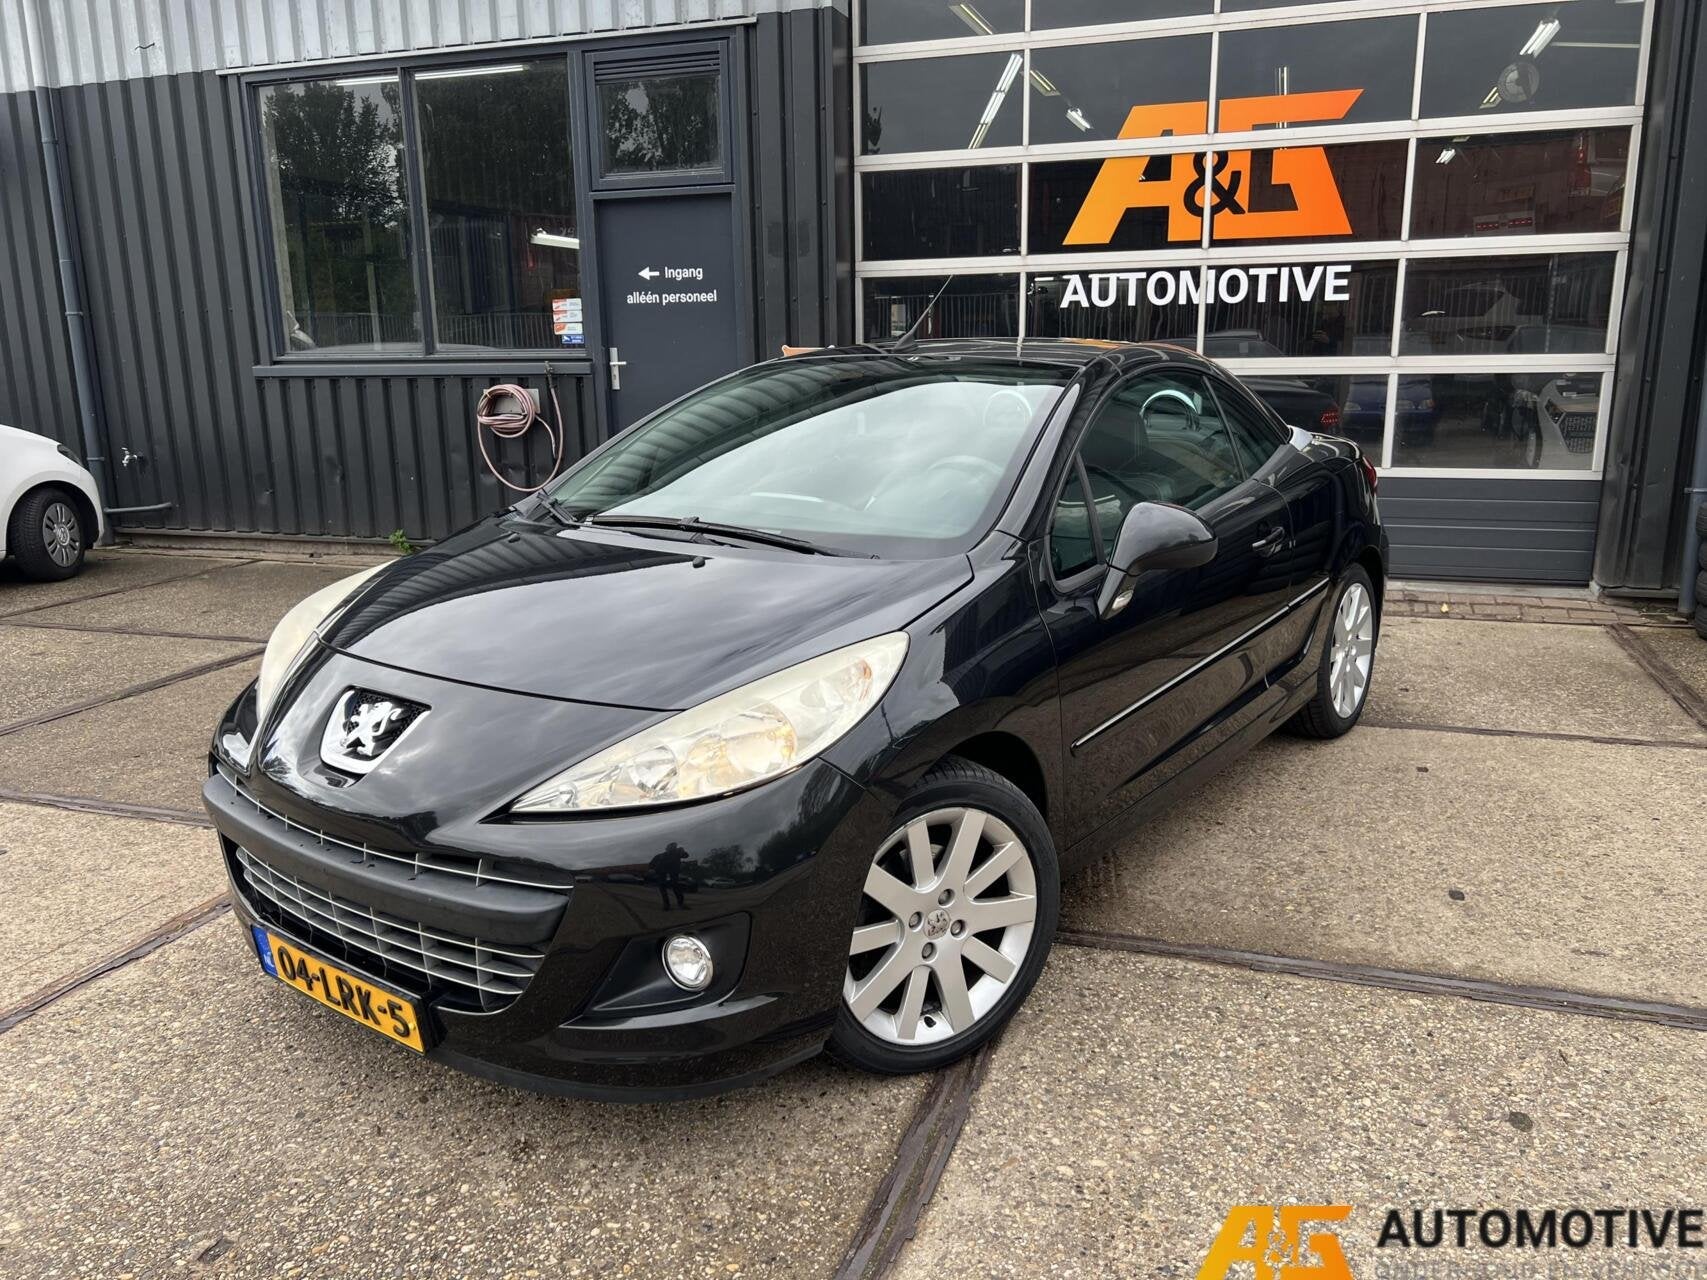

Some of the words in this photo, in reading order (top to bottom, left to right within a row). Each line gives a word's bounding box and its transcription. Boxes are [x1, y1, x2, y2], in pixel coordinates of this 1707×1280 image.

[1062, 88, 1364, 245] A&G
[664, 266, 703, 281] Ingang
[1060, 265, 1352, 309] AUTOMOTIVE
[626, 291, 660, 304] alléén
[662, 289, 717, 306] personeel
[277, 945, 410, 1038] 04-LRK-5
